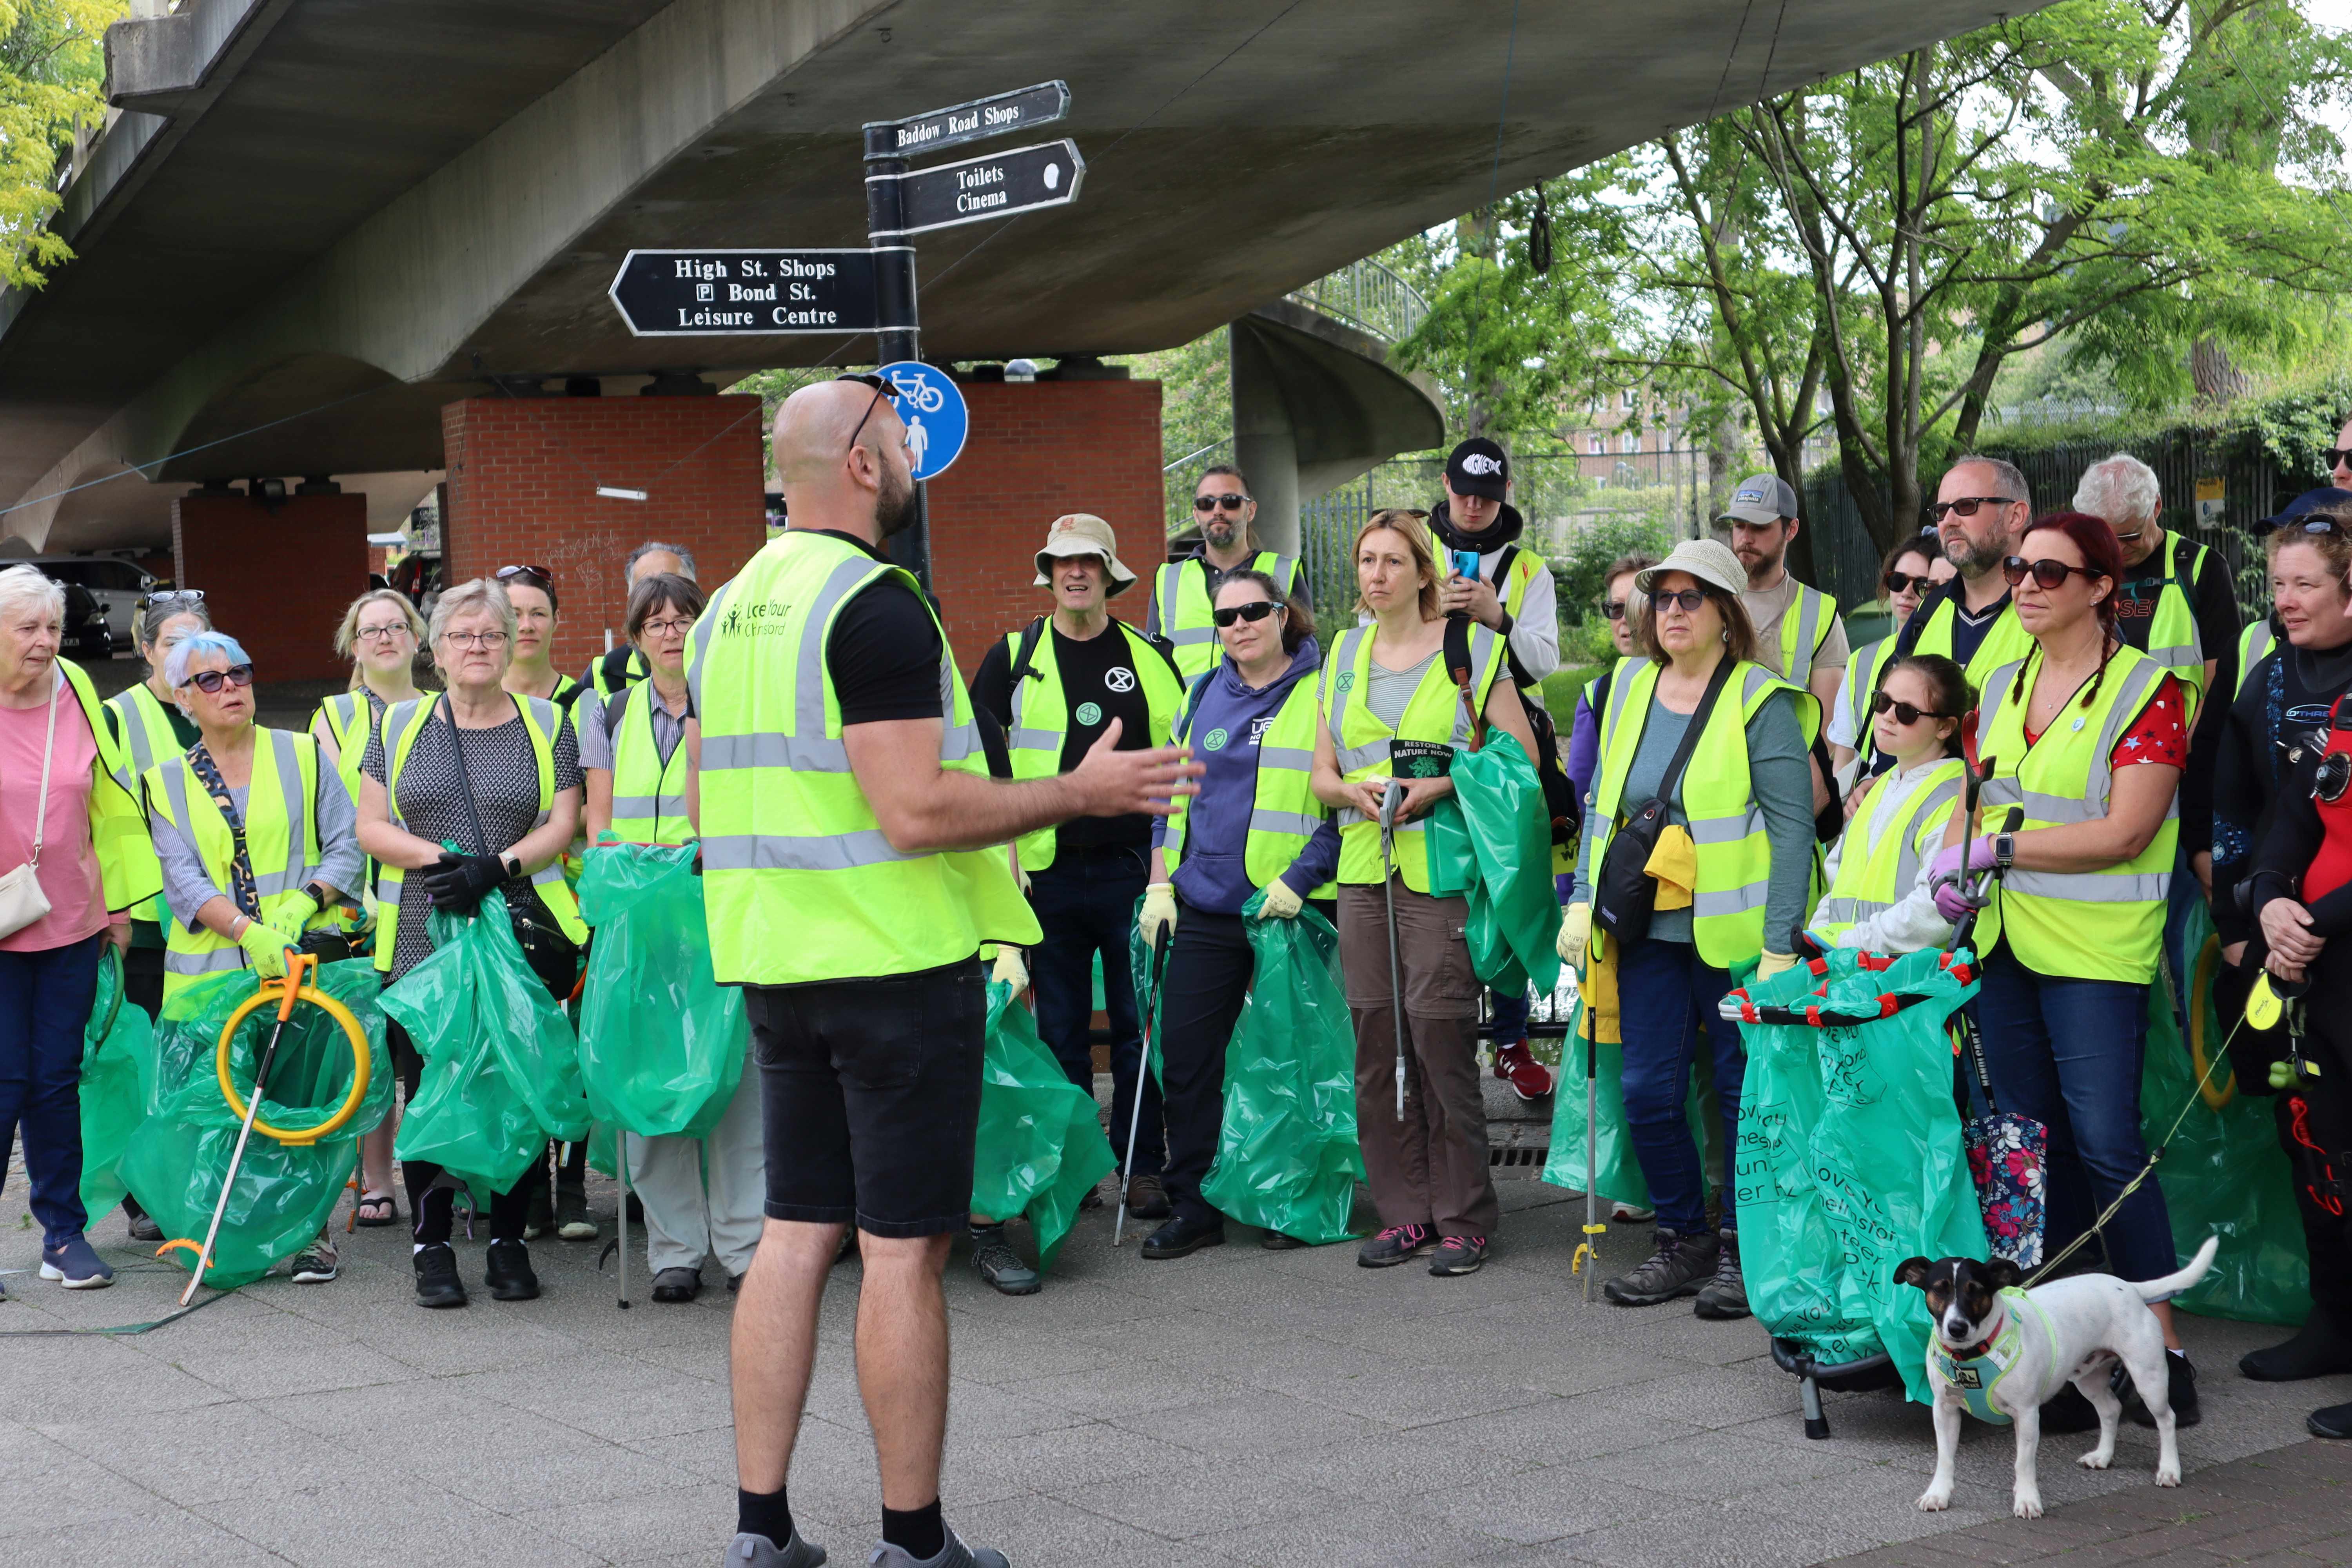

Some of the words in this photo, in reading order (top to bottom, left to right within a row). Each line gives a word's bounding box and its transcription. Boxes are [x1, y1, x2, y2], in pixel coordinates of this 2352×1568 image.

[897, 124, 940, 147] Baddow
[949, 111, 978, 134] Road
[985, 106, 1019, 125] Shops
[956, 165, 1004, 189] Toilets
[956, 191, 1007, 212] Cinema
[674, 259, 728, 280] High
[741, 260, 768, 277] St.
[780, 259, 836, 279] Shops
[728, 283, 777, 301] Bond
[789, 283, 816, 300] St.
[678, 307, 753, 326] Leisure
[772, 306, 837, 325] Centre
[1463, 454, 1501, 475] MAGNETAR
[768, 599, 792, 617] Your
[1394, 749, 1428, 759] NATURE
[1430, 750, 1452, 758] NOW
[1405, 741, 1441, 750] RESTORE
